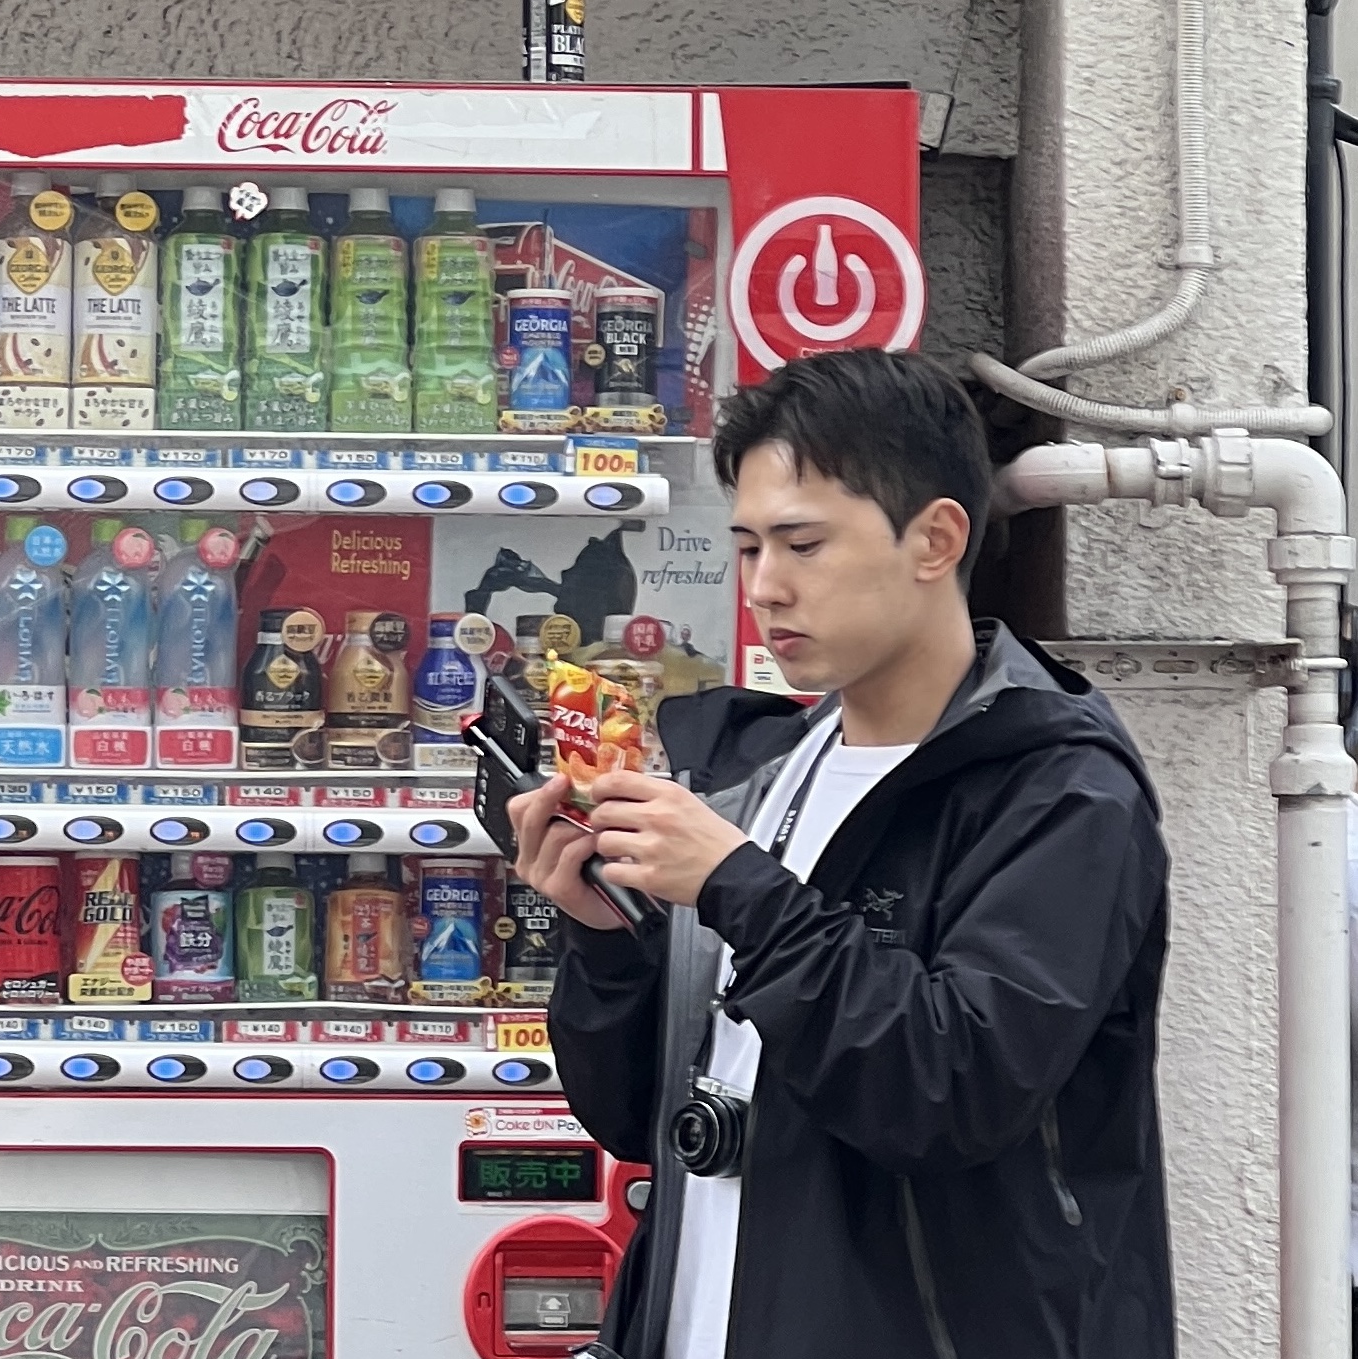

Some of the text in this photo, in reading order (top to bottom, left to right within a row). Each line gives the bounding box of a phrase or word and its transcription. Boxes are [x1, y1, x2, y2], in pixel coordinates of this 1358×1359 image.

[216, 96, 398, 156] Coca-Cola
[2, 297, 57, 314] THE LATTE
[87, 298, 142, 315] THE LATTE
[514, 317, 568, 332] GEORGIA
[606, 332, 647, 345] BLACK
[581, 452, 636, 474] 100円
[332, 530, 403, 551] Delicious
[657, 526, 712, 554] Drive
[331, 552, 411, 580] Refreshing
[642, 561, 728, 589] refreshed
[85, 891, 135, 906] REAL
[426, 888, 480, 902] GEORGIA
[83, 906, 133, 923] GOLD
[517, 906, 558, 918] BLACK
[502, 1028, 548, 1048] 100
[496, 1118, 584, 1134] Coke ON Pay
[479, 1159, 582, 1189] 販売中
[73, 1258, 104, 1271] AND
[105, 1254, 240, 1275] REFRESHING
